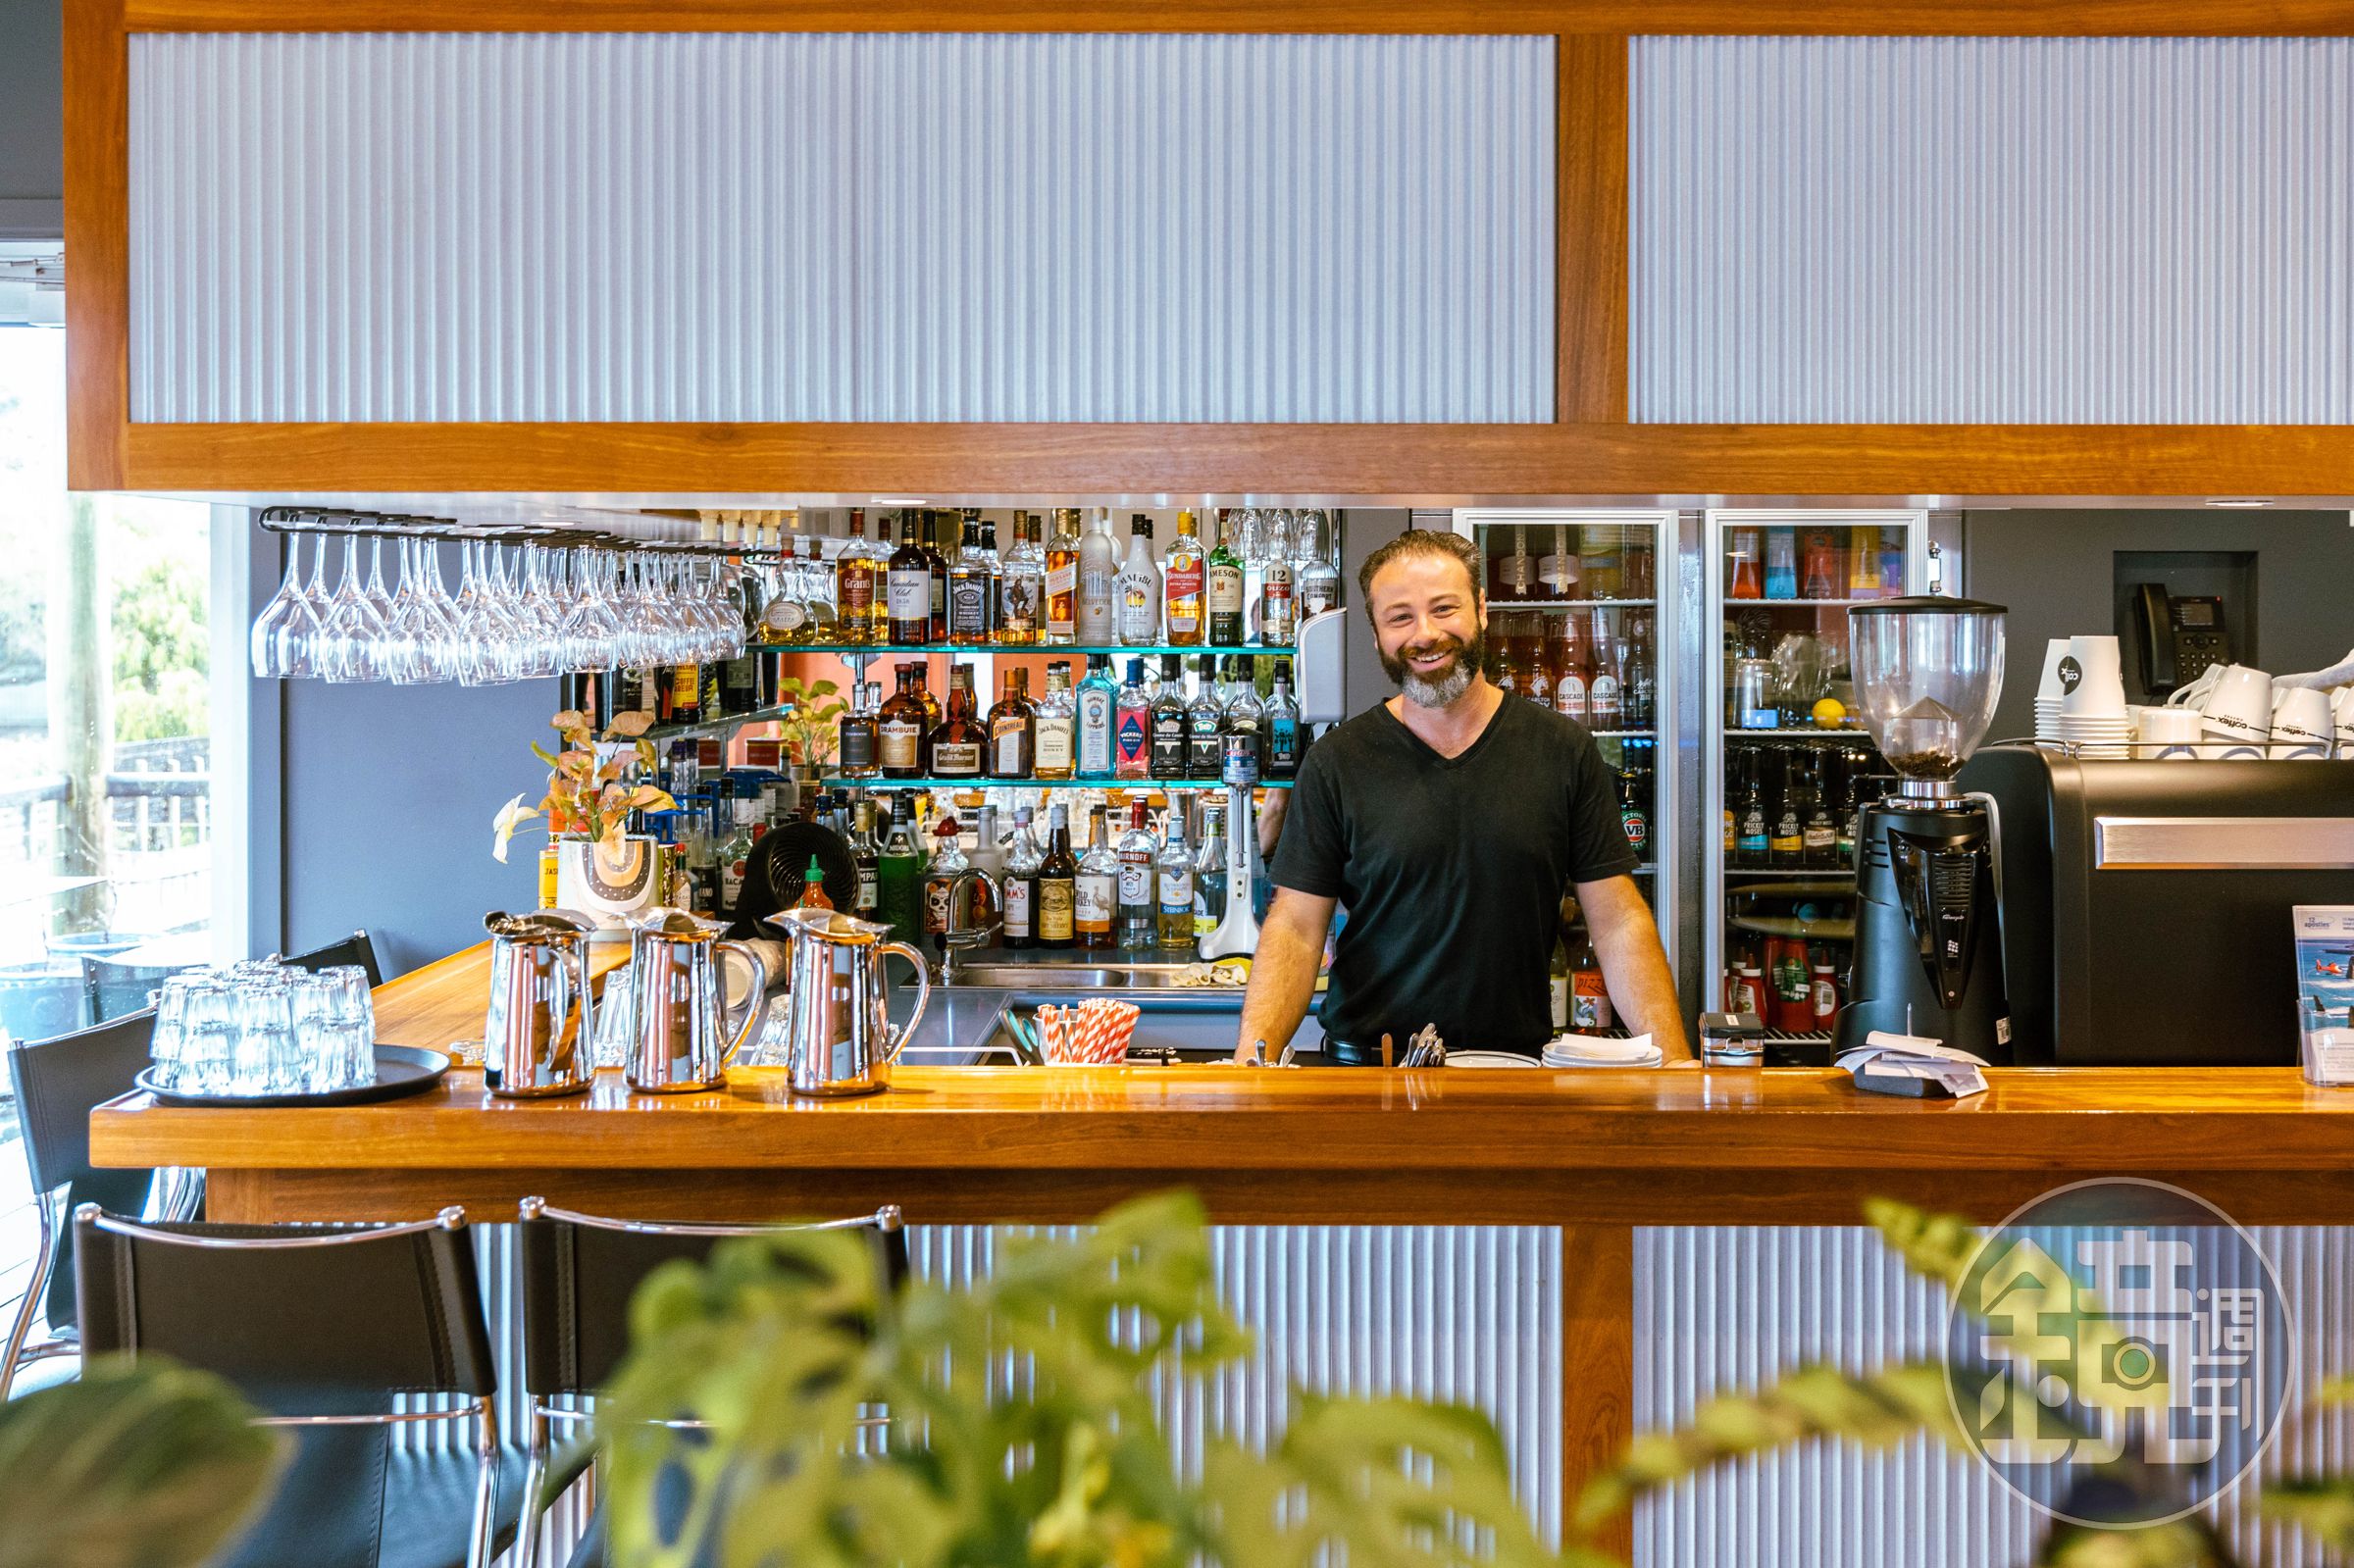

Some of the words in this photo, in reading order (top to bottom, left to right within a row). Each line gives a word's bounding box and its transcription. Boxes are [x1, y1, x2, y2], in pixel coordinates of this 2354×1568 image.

[1516, 533, 1525, 588] CHANDON
[1120, 574, 1153, 588] MALIBU
[1208, 570, 1240, 580] AMESON
[1271, 570, 1287, 582] 12
[1625, 826, 1645, 835] VB
